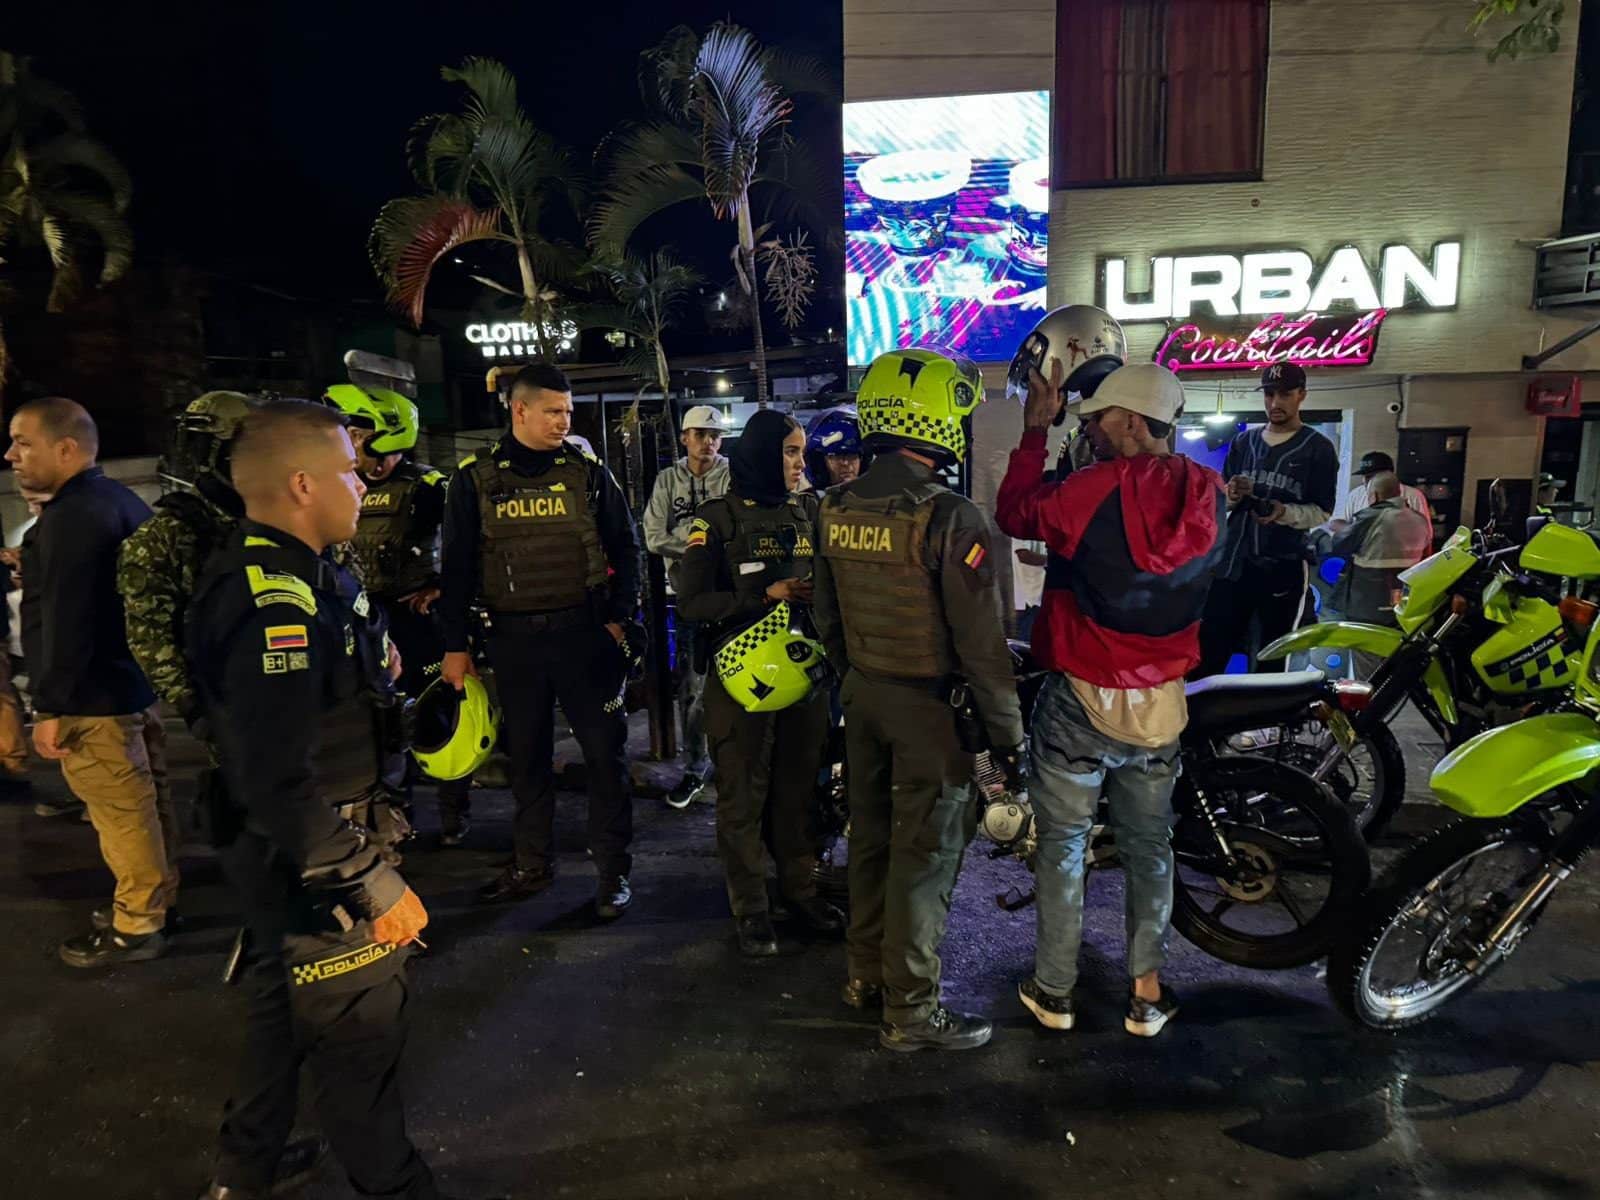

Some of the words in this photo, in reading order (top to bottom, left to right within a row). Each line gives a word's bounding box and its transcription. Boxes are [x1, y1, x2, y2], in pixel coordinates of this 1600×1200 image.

[1104, 242, 1461, 320] URBAN
[482, 344, 562, 357] MARK
[360, 493, 391, 507] ICIA
[496, 497, 567, 519] POLICIA
[829, 524, 893, 552] POLICIA
[267, 657, 284, 670] B+
[323, 945, 384, 976] POLICÍA
